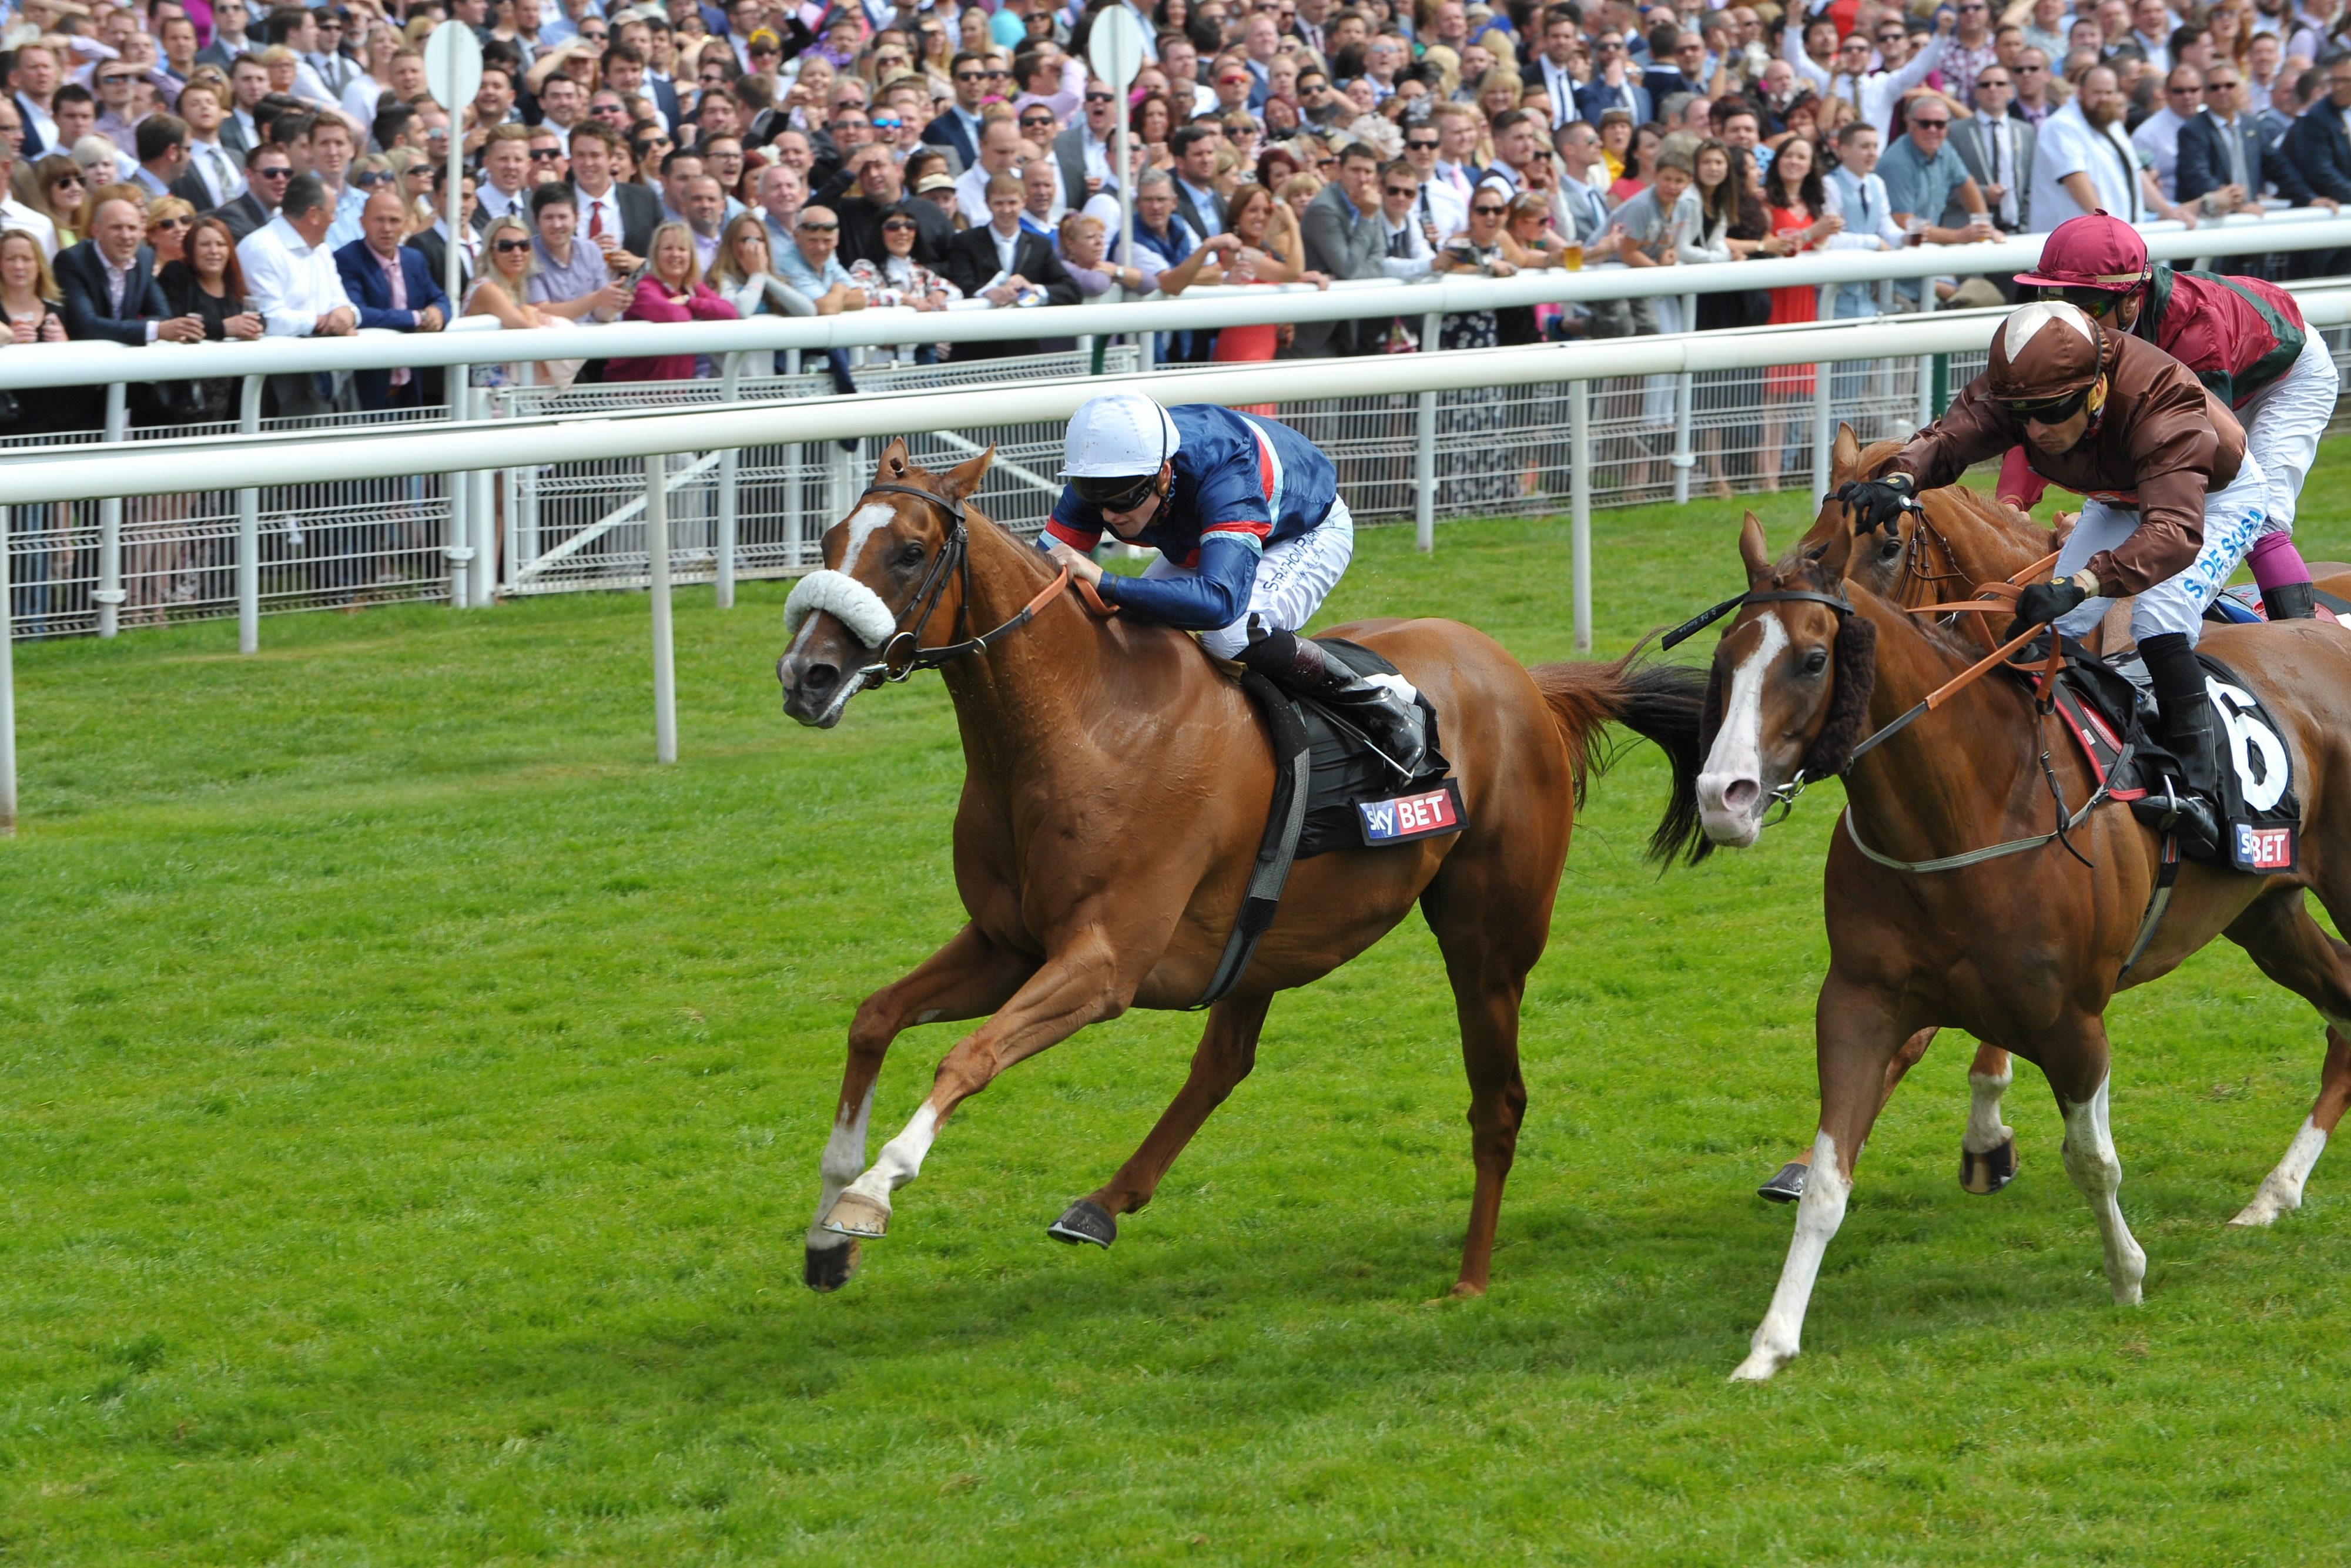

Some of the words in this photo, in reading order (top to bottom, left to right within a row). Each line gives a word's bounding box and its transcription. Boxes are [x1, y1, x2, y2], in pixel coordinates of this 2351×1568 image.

[2199, 549, 2224, 581] DE
[2205, 675, 2289, 812] 6
[1398, 795, 1444, 829] BET
[2252, 834, 2286, 862] BET
